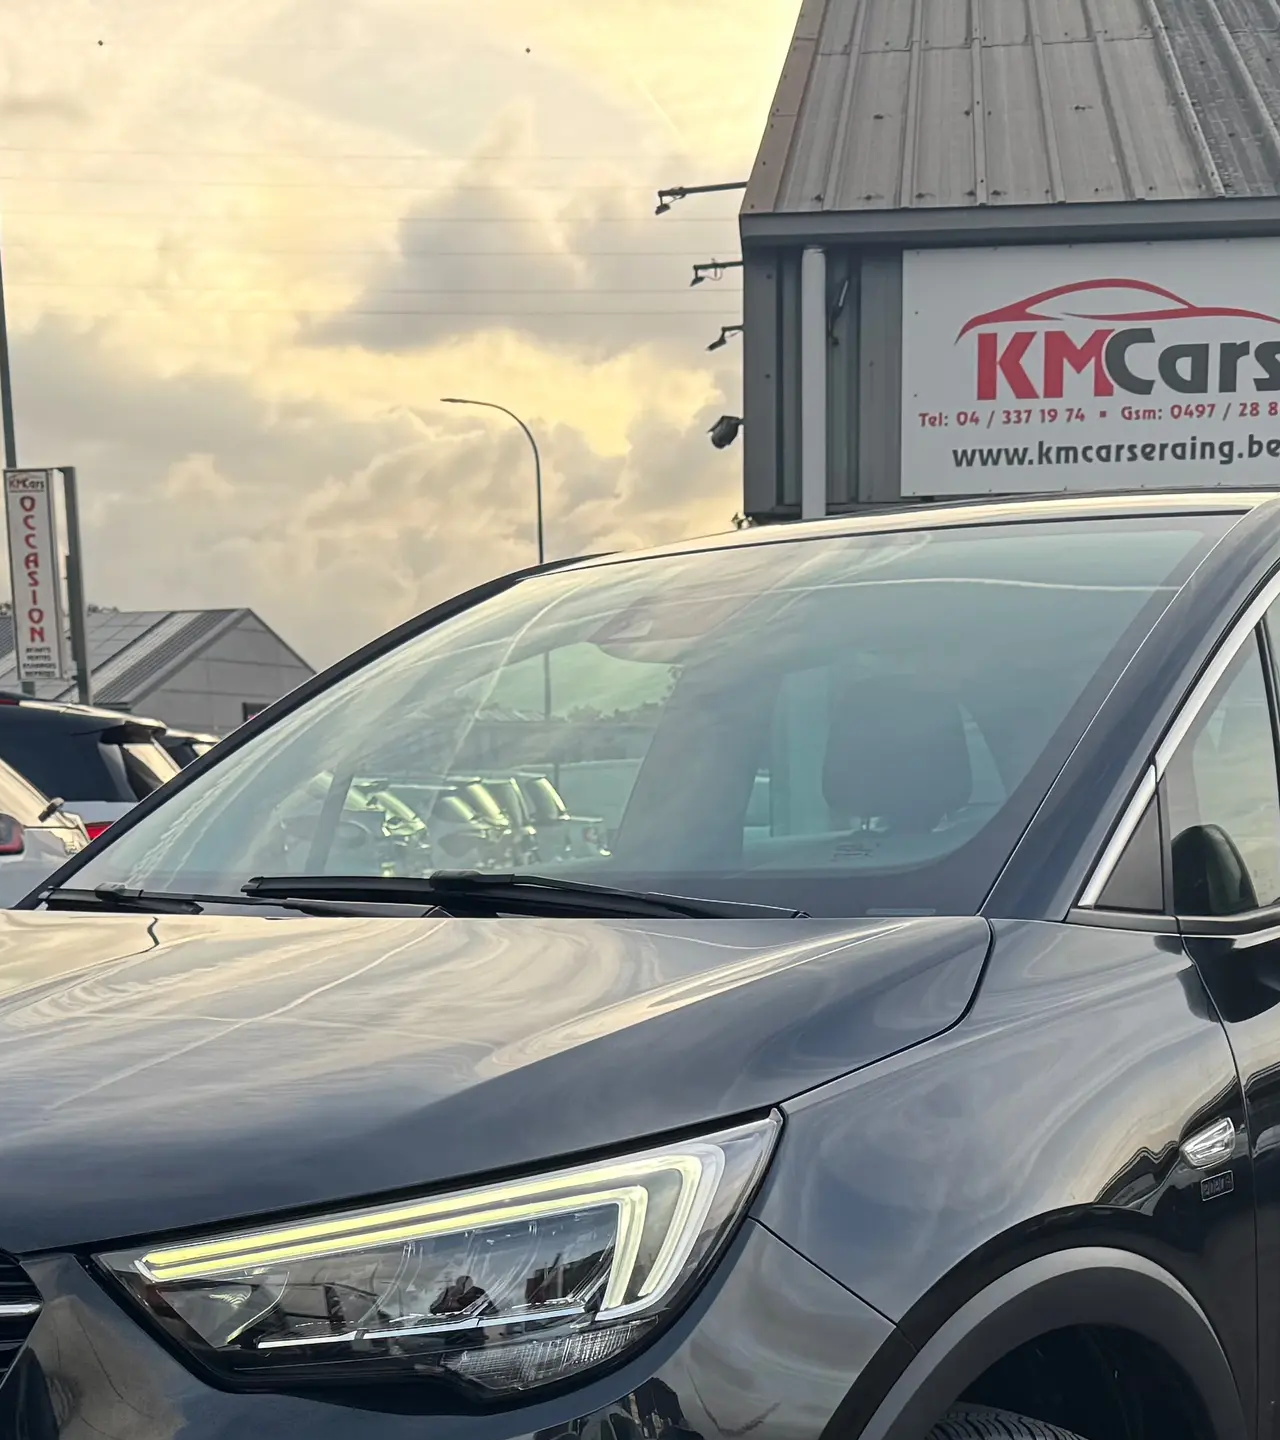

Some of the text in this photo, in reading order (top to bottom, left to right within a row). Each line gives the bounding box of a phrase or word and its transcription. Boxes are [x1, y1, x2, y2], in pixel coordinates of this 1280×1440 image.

[919, 411, 949, 428] Tel:
[956, 410, 980, 426] 04
[1002, 409, 1033, 425] 337
[1040, 408, 1059, 423] 19
[1065, 407, 1086, 422] 74
[1121, 405, 1163, 421] Gsm:
[1170, 403, 1216, 420] 0497
[1238, 401, 1260, 417] 28
[20, 495, 45, 643] OCCASION
